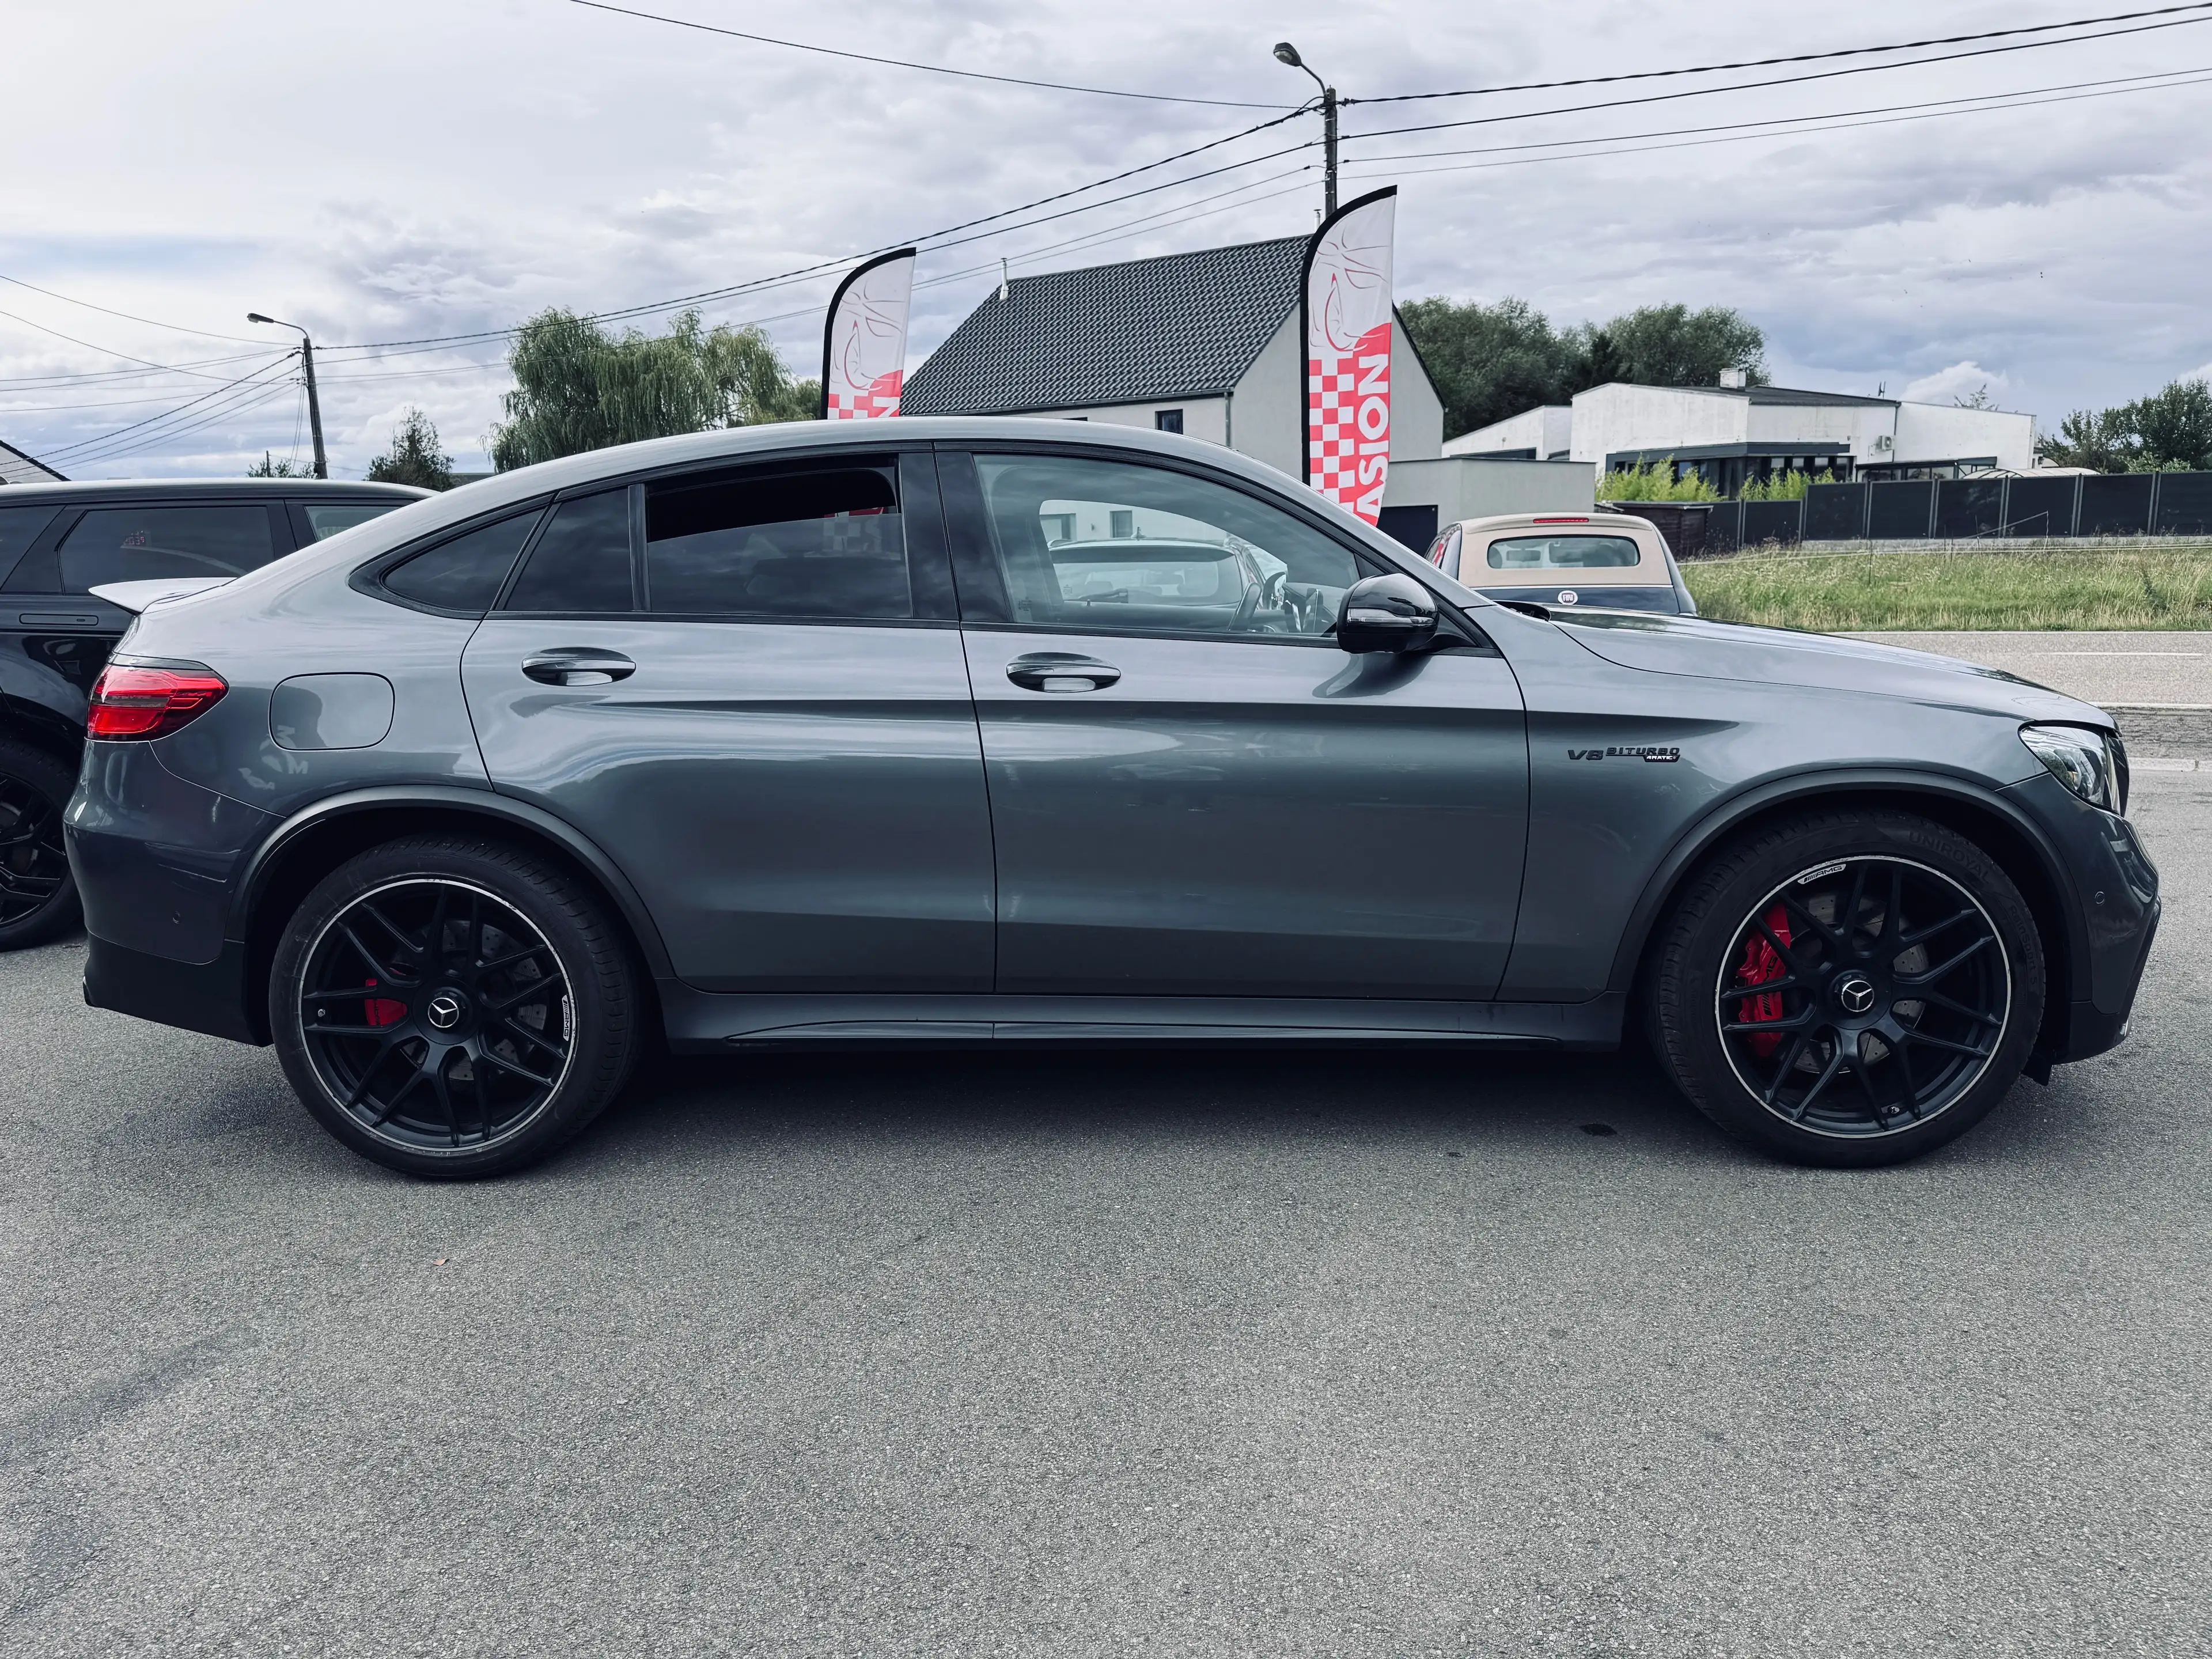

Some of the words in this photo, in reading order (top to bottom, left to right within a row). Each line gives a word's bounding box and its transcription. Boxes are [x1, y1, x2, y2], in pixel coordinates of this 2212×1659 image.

[1567, 749, 1604, 760] V8
[1606, 747, 1680, 755] BITURBO
[1909, 831, 1990, 885] UNIROYAL
[2009, 904, 2037, 971] RainSport
